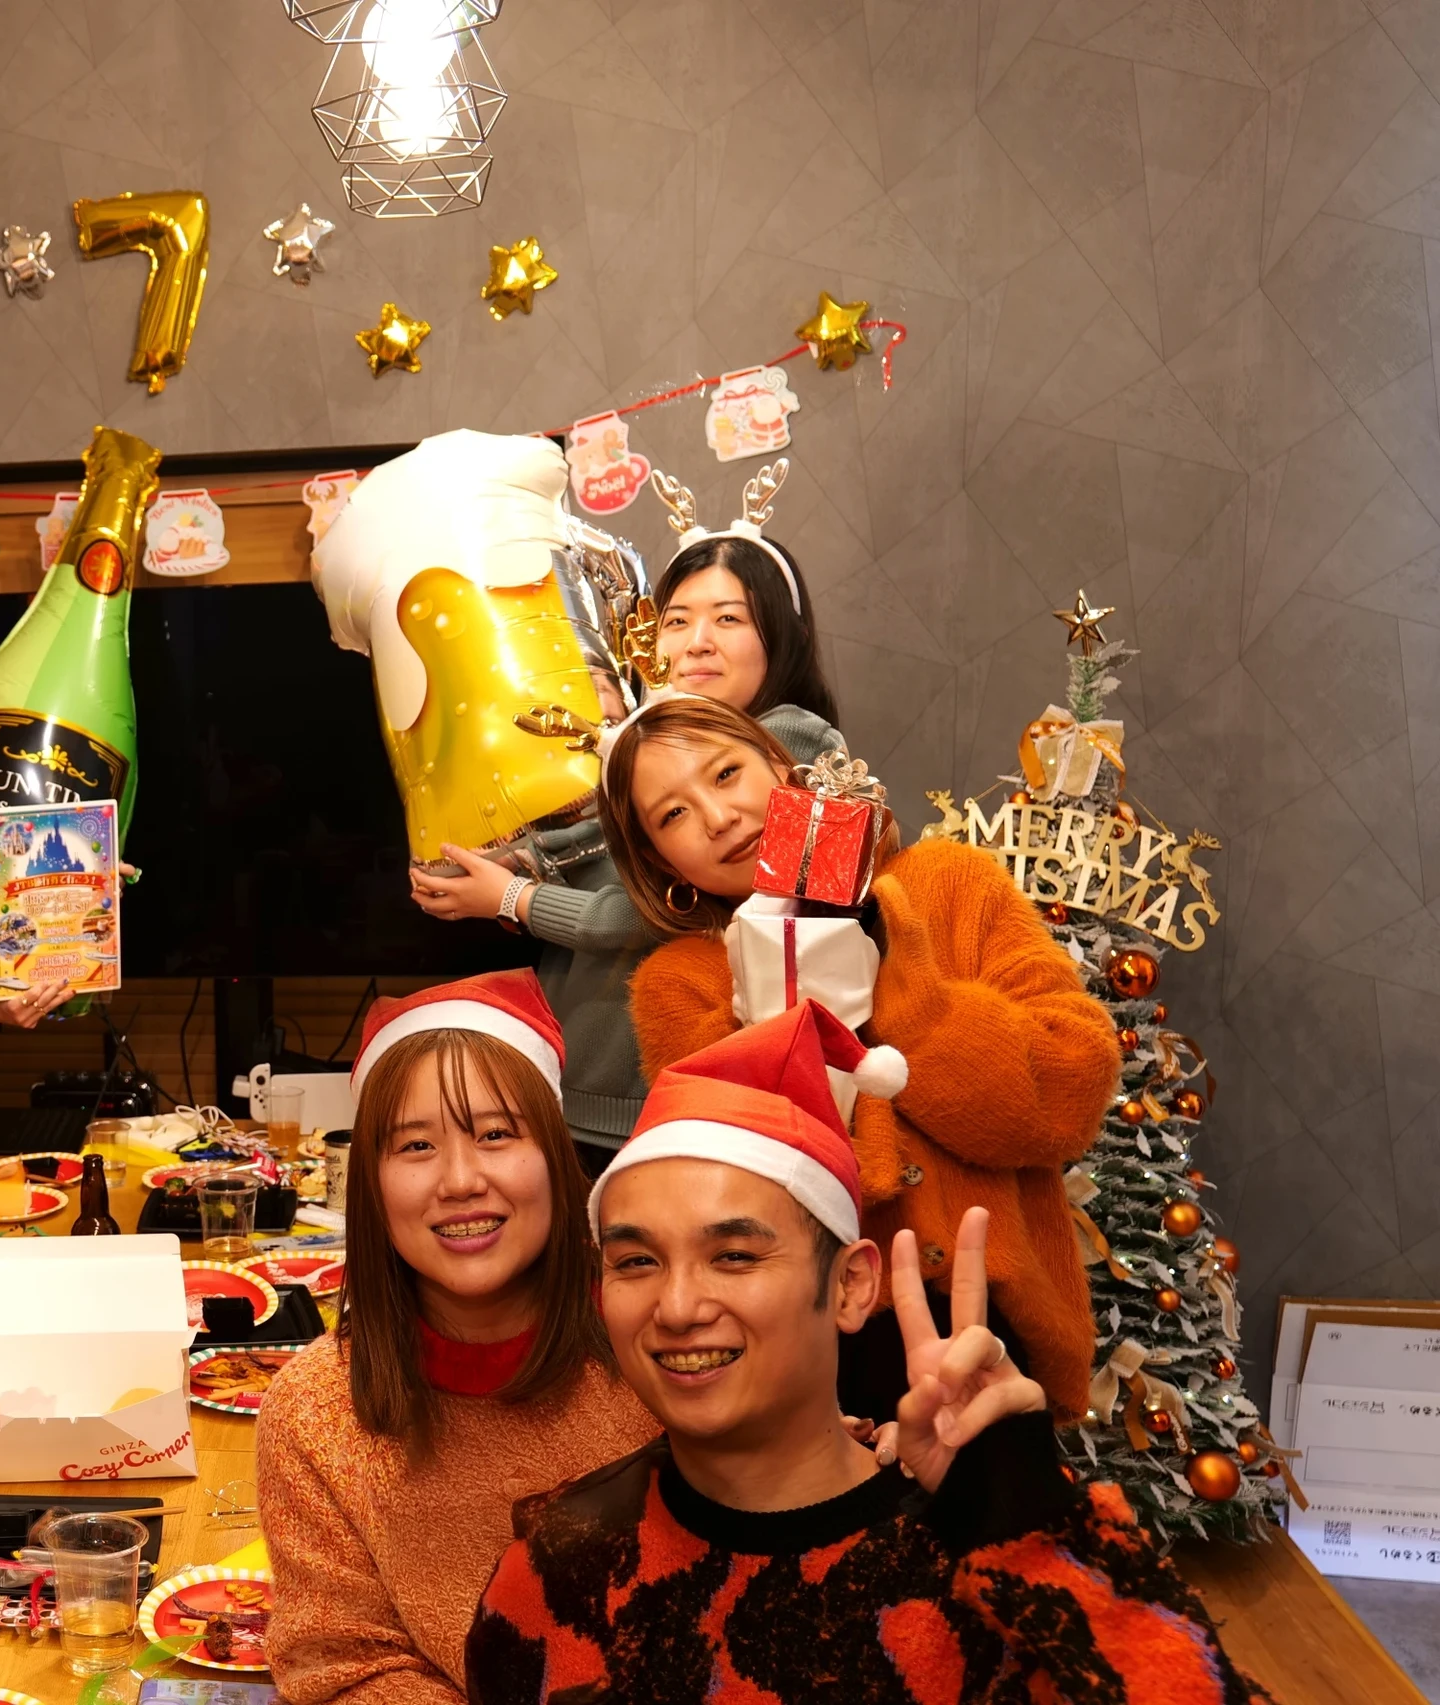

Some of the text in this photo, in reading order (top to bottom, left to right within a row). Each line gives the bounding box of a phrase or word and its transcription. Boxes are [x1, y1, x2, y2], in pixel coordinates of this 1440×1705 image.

[965, 798, 1176, 879] MERRY
[59, 1430, 192, 1481] Cozy Corner
[99, 1439, 148, 1457] GINZA
